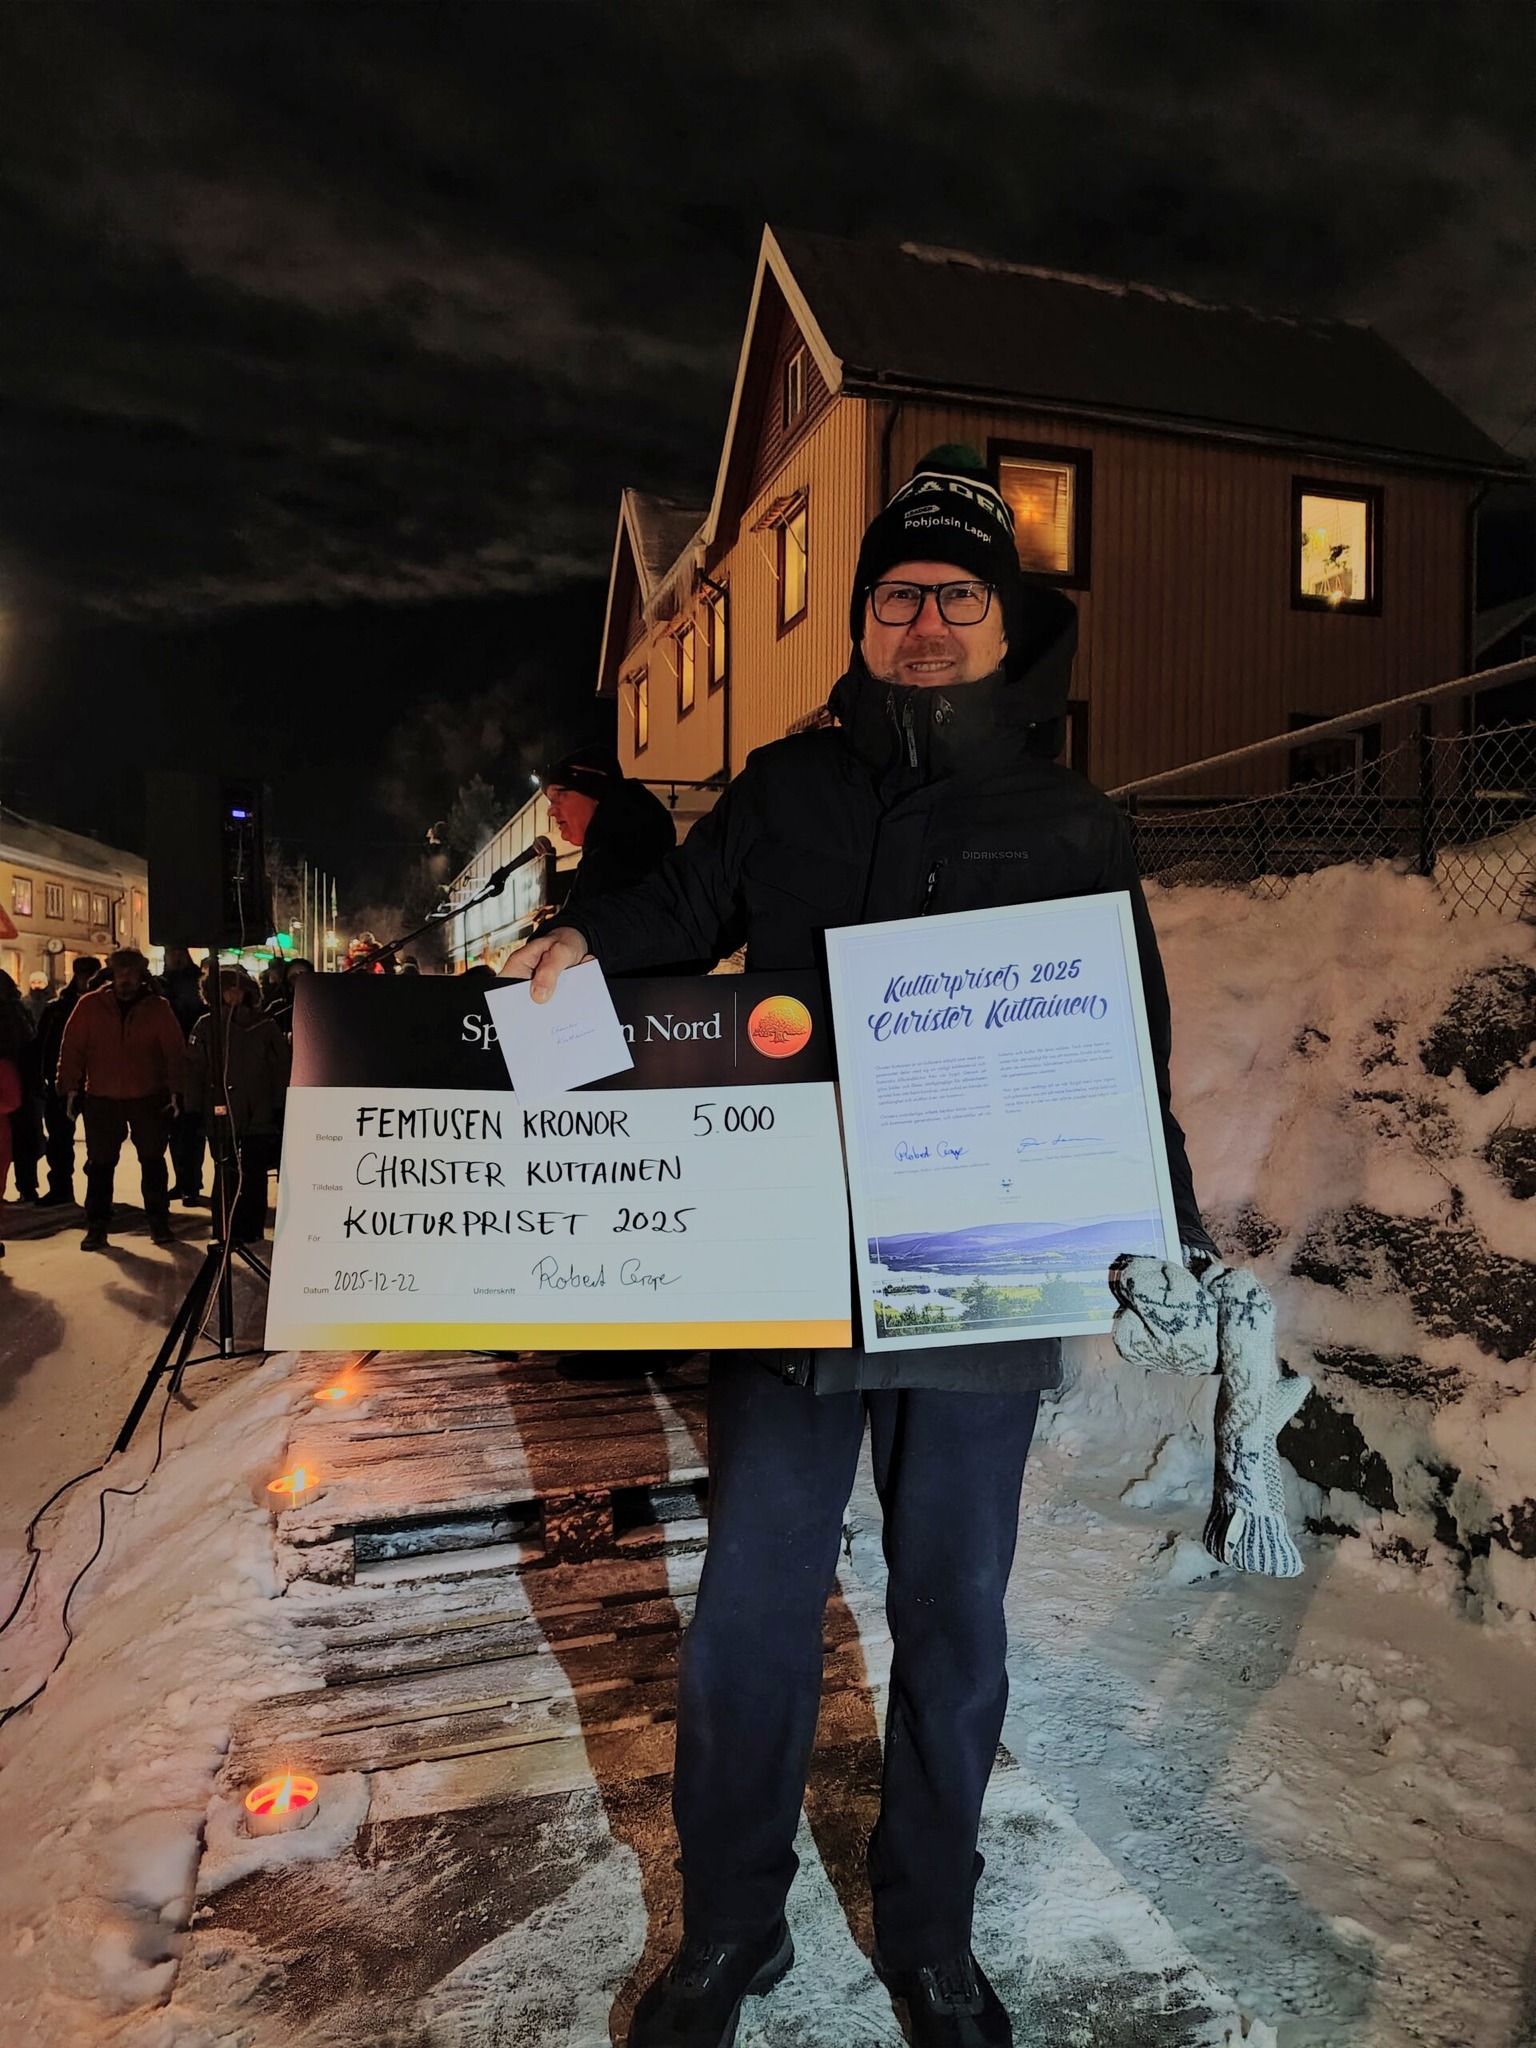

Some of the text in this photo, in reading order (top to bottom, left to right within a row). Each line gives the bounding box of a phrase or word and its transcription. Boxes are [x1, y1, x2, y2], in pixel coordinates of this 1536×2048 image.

[965, 522, 992, 543] Lappi
[962, 850, 1029, 860] DIDRIKSONS
[883, 959, 1082, 1003] Kulturpriset 2025
[644, 1012, 722, 1042] Nord
[868, 995, 1107, 1041] Christer Kuttainen
[356, 1103, 775, 1140] FEMTUSEN KRONOR 5.000
[315, 1133, 343, 1142] Belopp
[356, 1151, 681, 1187] CHRISTER KUTTAINEN
[311, 1183, 343, 1191] Tilldelas
[343, 1205, 697, 1238] KULTURPRISET 2025
[307, 1233, 321, 1242] För
[334, 1269, 420, 1292] 2025-12-22
[473, 1285, 516, 1295] Underskrift
